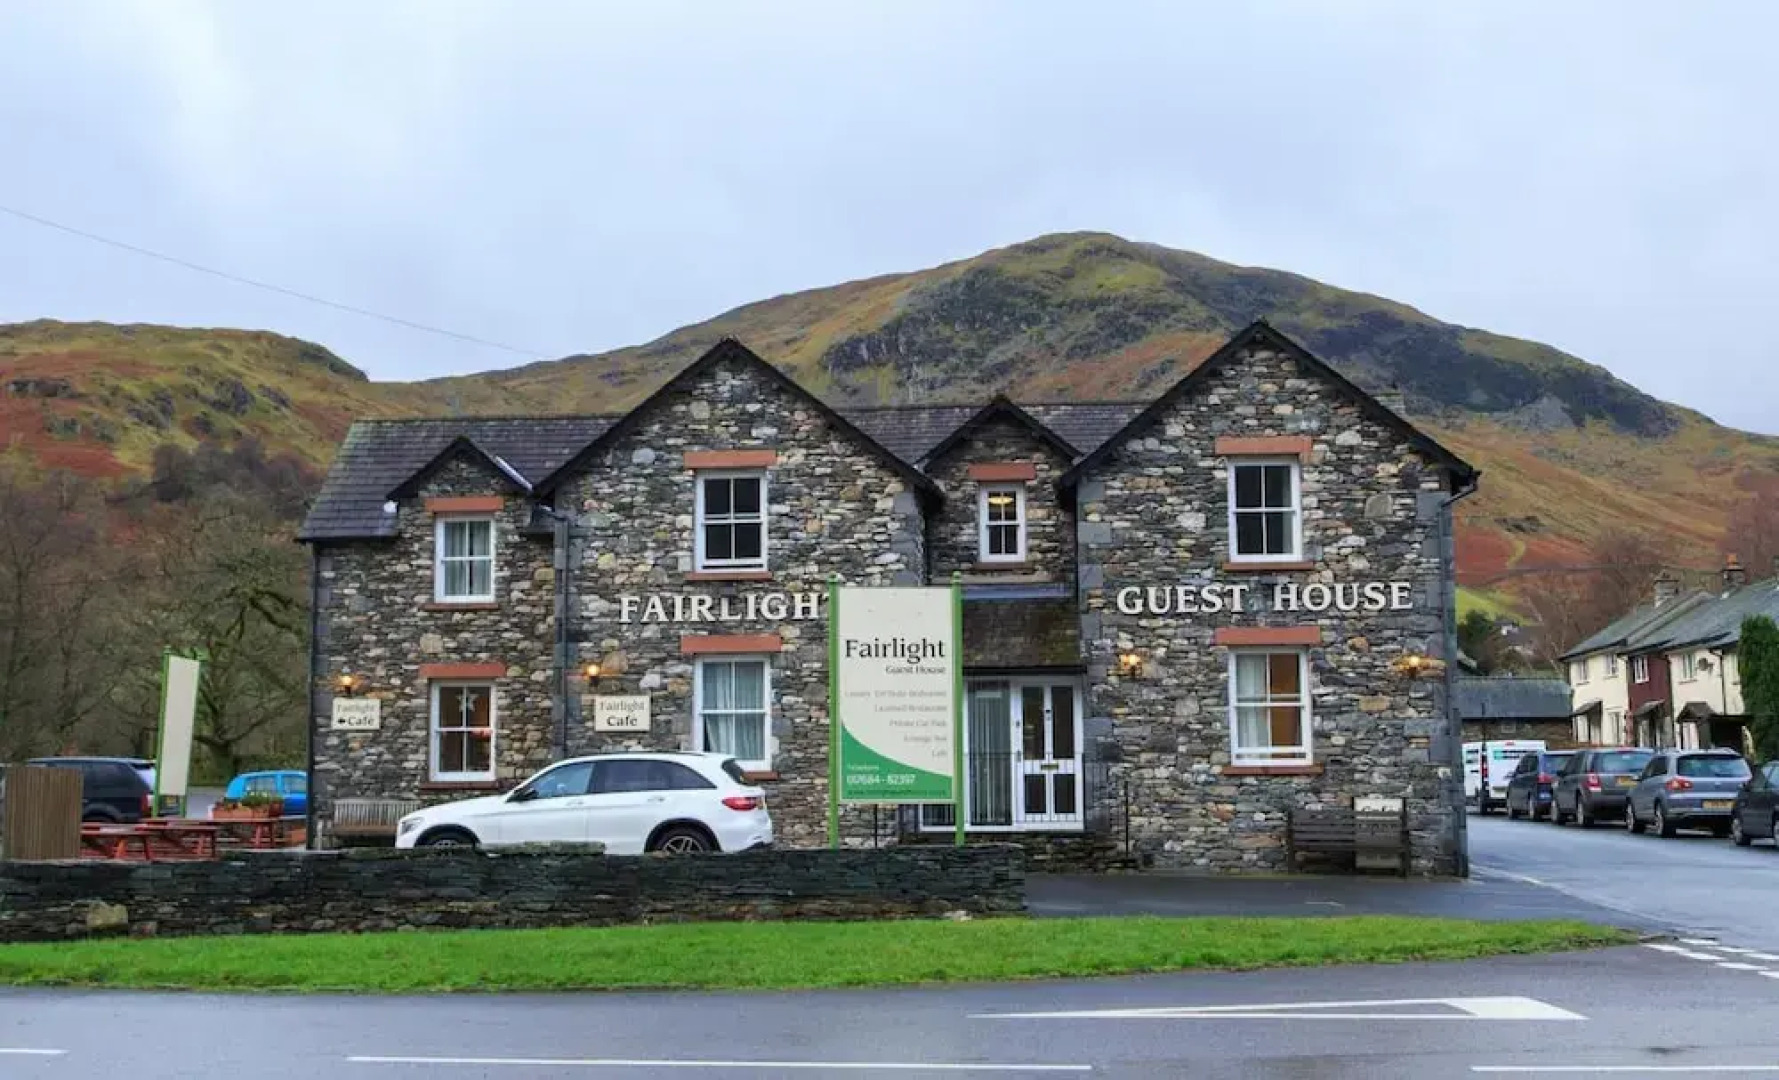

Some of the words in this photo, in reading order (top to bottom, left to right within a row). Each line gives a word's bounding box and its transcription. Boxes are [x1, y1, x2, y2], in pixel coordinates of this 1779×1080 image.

[619, 592, 829, 623] FAIRLIGH
[1116, 583, 1250, 615] GUEST
[1273, 581, 1414, 611] HOUSE
[844, 637, 946, 664] Fairlight
[885, 665, 914, 674] Guest
[915, 665, 946, 674] House
[600, 700, 645, 712] Fairlight
